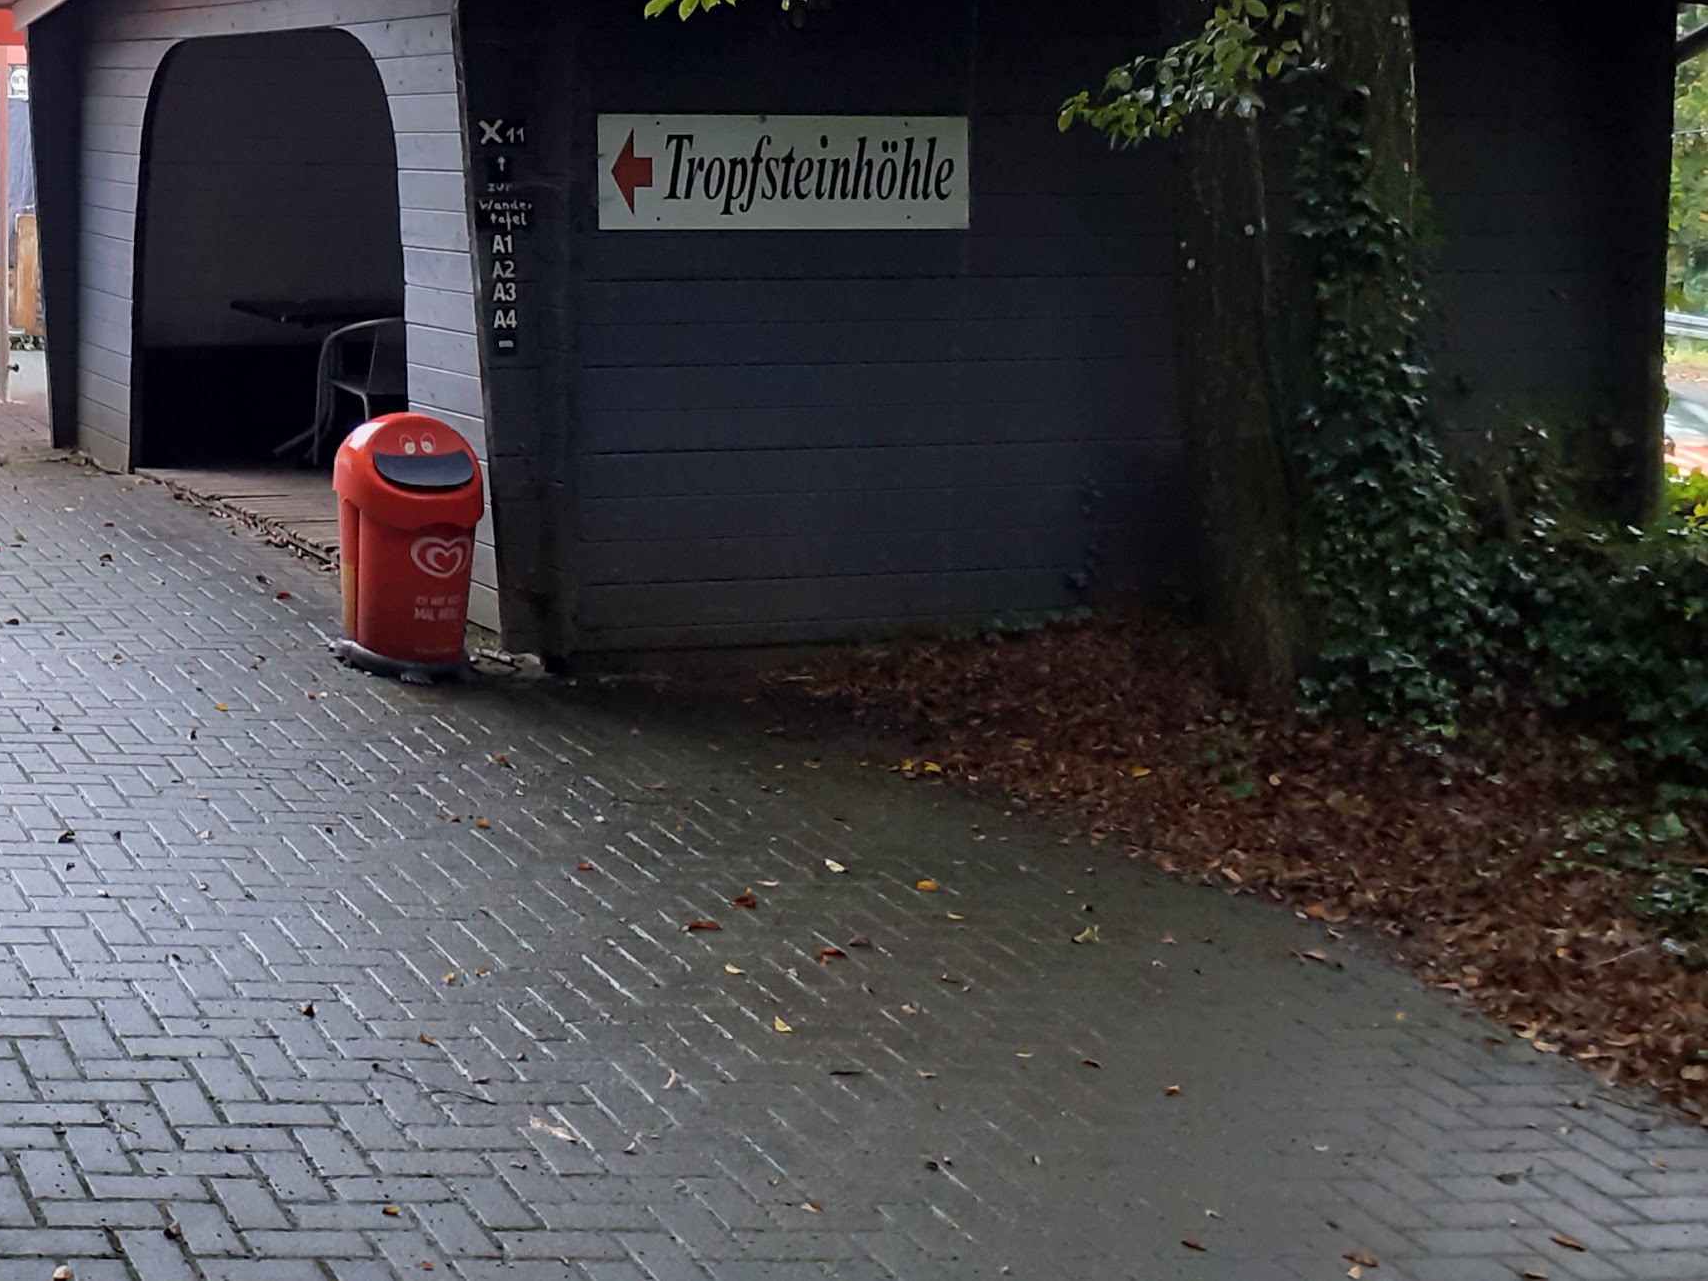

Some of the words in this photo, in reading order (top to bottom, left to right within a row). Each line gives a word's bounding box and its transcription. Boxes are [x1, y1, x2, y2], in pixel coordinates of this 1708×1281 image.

[663, 134, 954, 215] Tropfsteinhöhle
[490, 211, 527, 229] tafel
[492, 235, 512, 253] A1
[493, 261, 515, 278] A2
[493, 283, 517, 301] A3
[494, 310, 517, 328] A4
